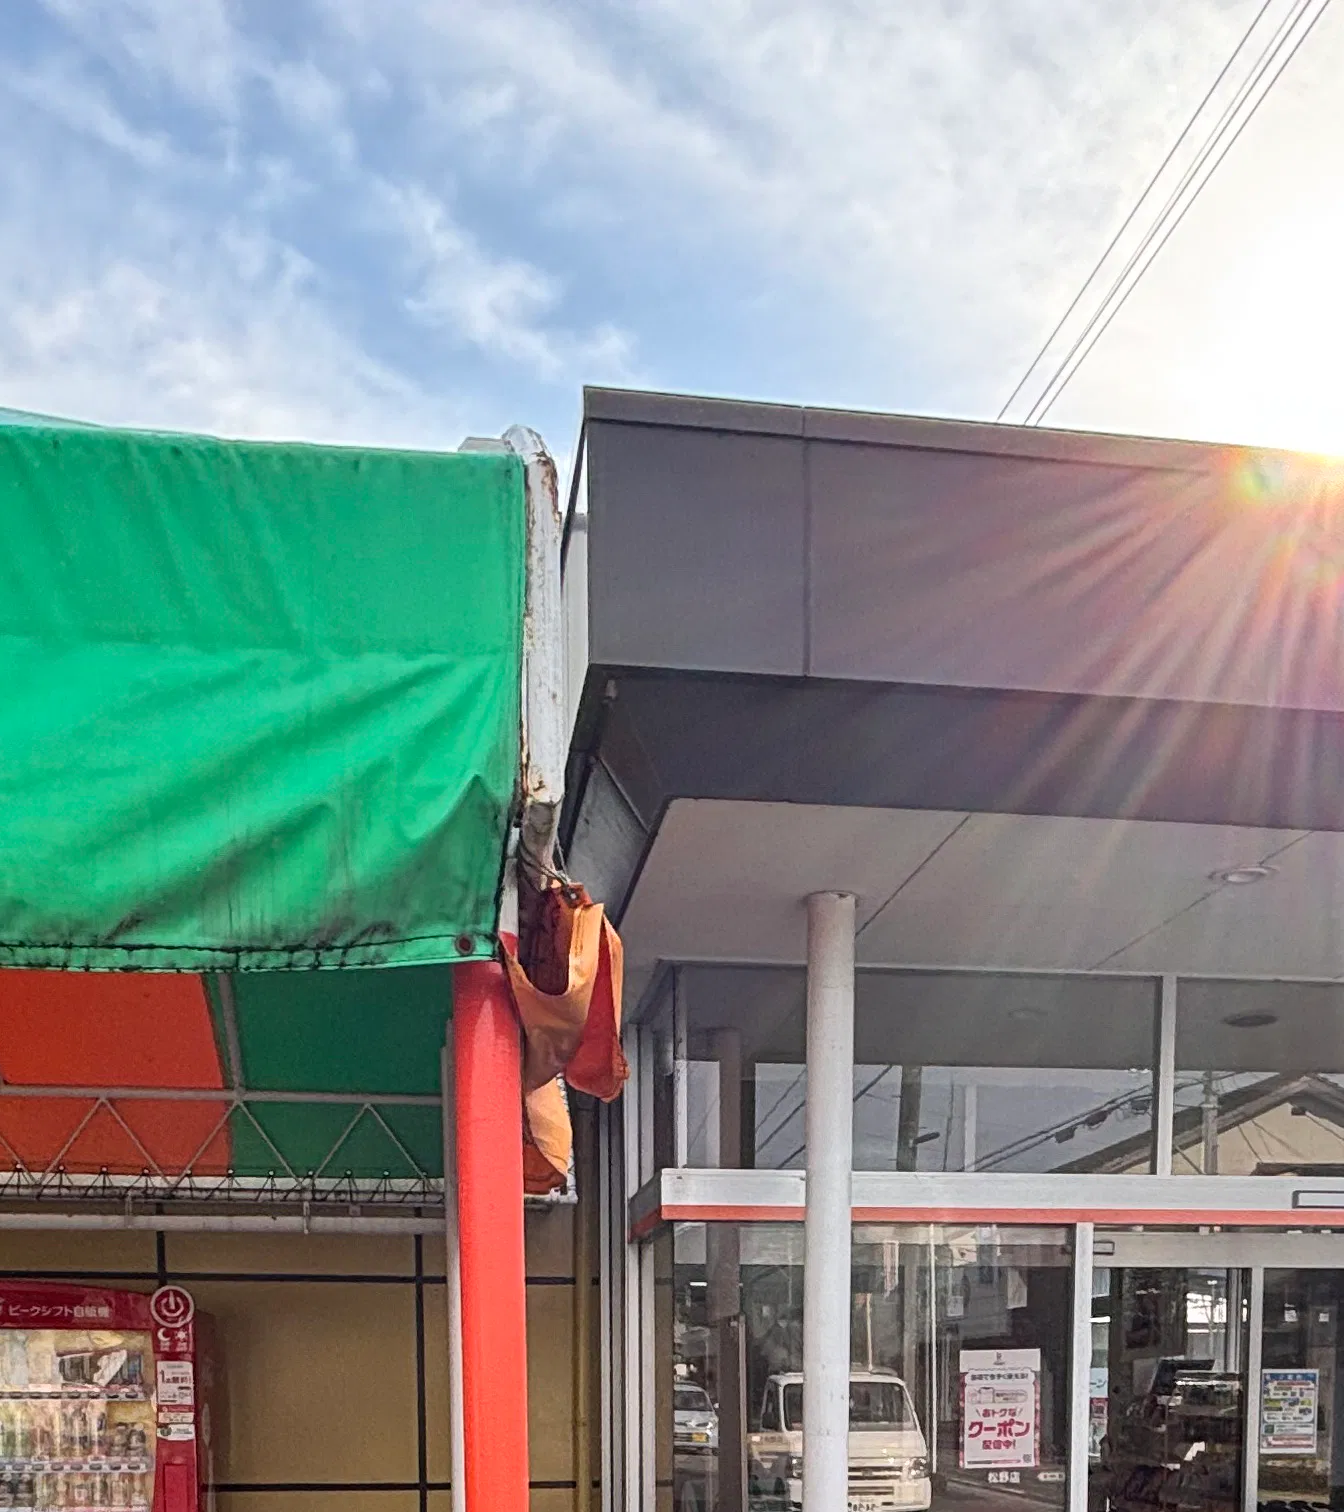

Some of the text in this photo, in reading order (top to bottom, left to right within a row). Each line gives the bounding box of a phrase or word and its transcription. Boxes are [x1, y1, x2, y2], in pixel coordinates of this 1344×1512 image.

[982, 1408, 1017, 1418] おトクな
[968, 1418, 1031, 1438] クーポン
